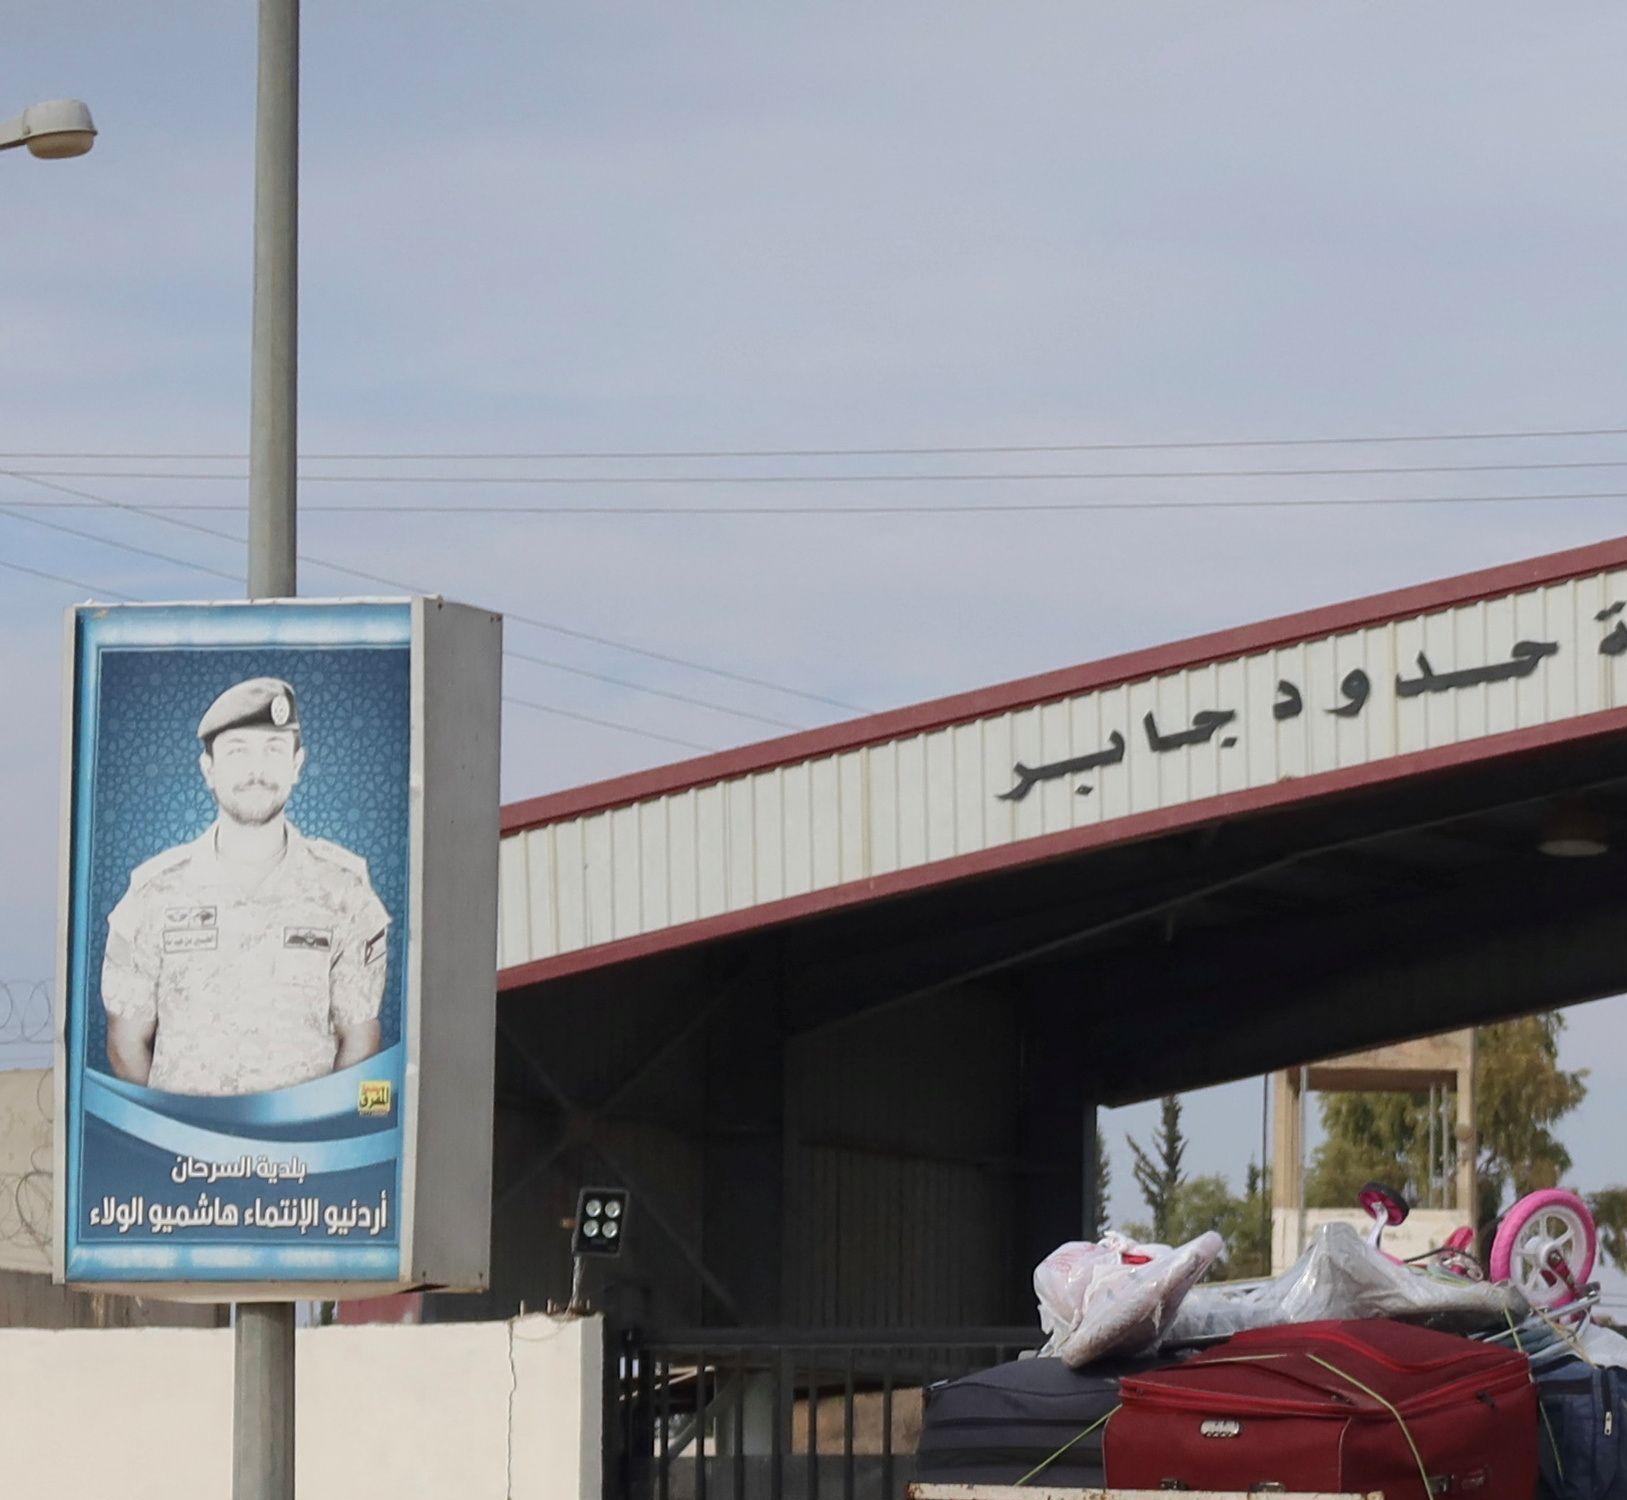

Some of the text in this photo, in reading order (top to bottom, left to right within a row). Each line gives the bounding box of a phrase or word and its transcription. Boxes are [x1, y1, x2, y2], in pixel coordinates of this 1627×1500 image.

[1273, 639, 1559, 717] حدود
[997, 706, 1237, 801] جابر
[171, 1155, 307, 1184] بلدية السرحان
[89, 1190, 388, 1235] أردنيو الإنتماء هاشميو الولاء
